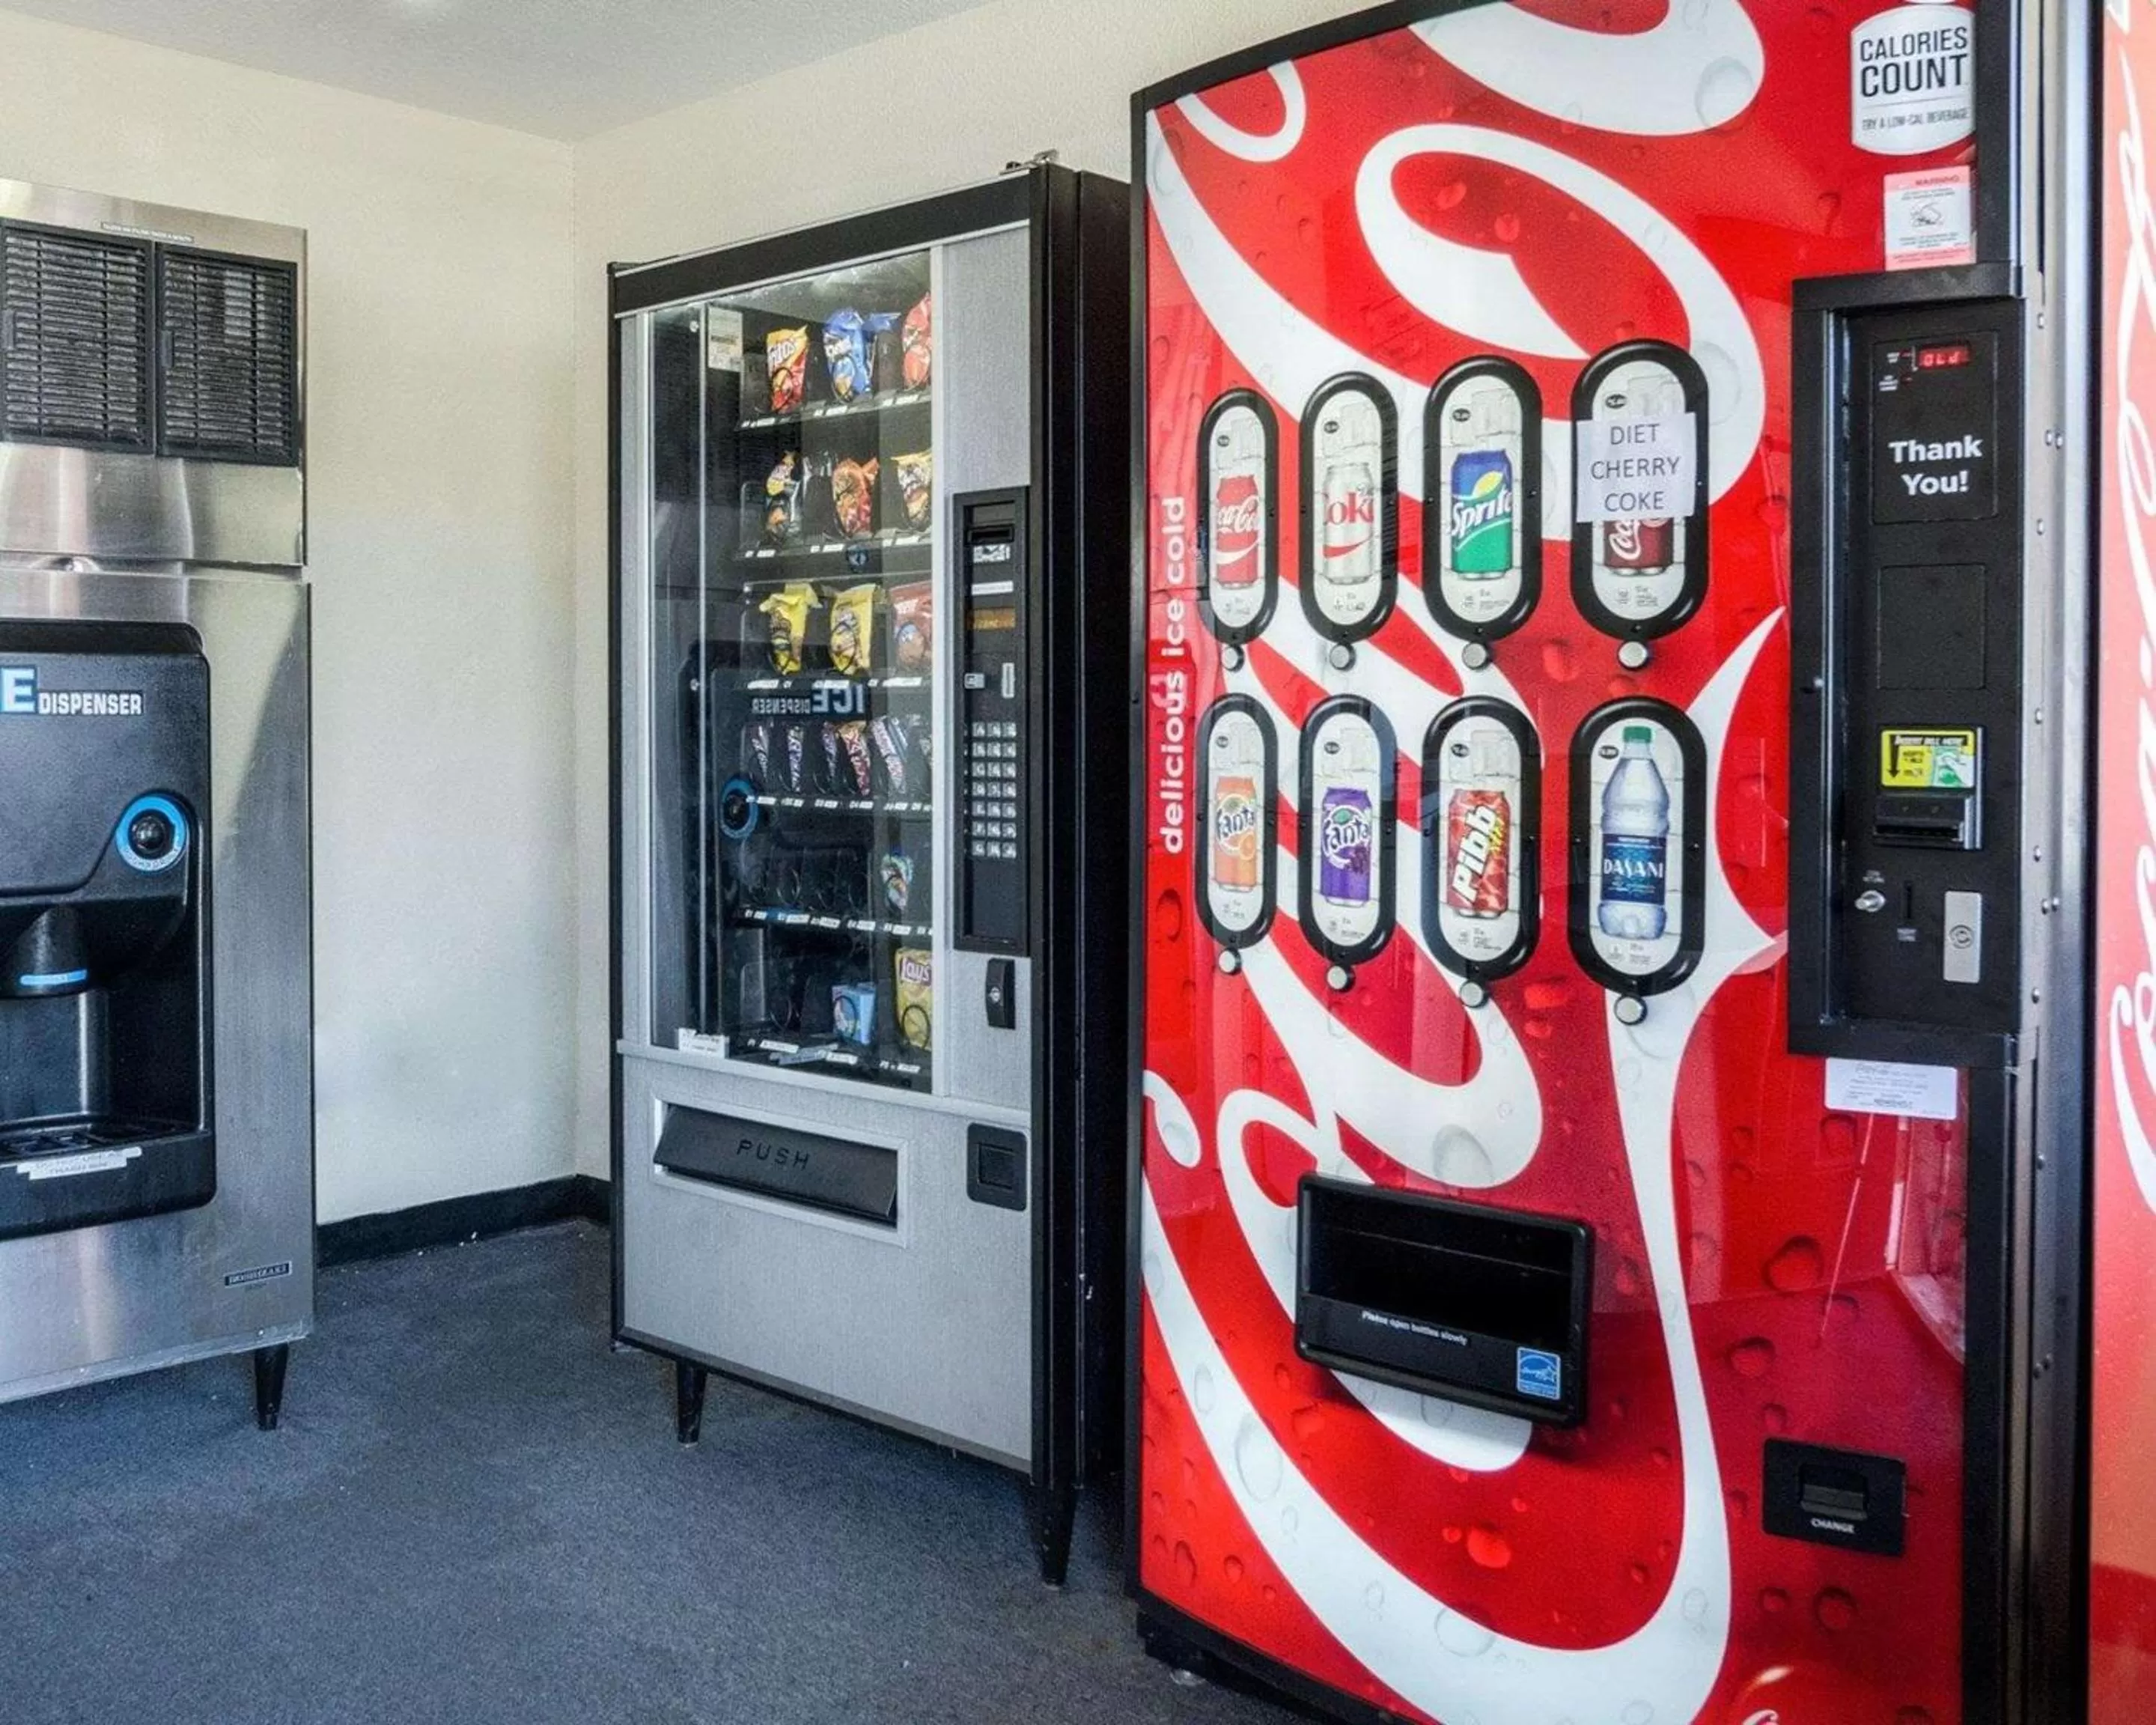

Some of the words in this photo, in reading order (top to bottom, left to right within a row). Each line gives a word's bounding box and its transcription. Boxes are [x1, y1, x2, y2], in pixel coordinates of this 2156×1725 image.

[1860, 26, 1968, 62] CALORIES
[1861, 54, 1968, 97] COUNT
[1610, 424, 1660, 445] DIET
[1888, 435, 1984, 463] Thank
[1591, 456, 1681, 480] CHERRY
[1901, 470, 1970, 496] You!
[1604, 491, 1665, 512] COKE
[1160, 496, 1185, 584] cold
[1161, 597, 1185, 657] ice
[38, 693, 142, 716] DISPENSER
[1160, 671, 1185, 854] delicious
[1604, 858, 1664, 878] DASANI
[736, 1139, 811, 1171] PUSH
[1812, 1518, 1855, 1535] CHANGE
